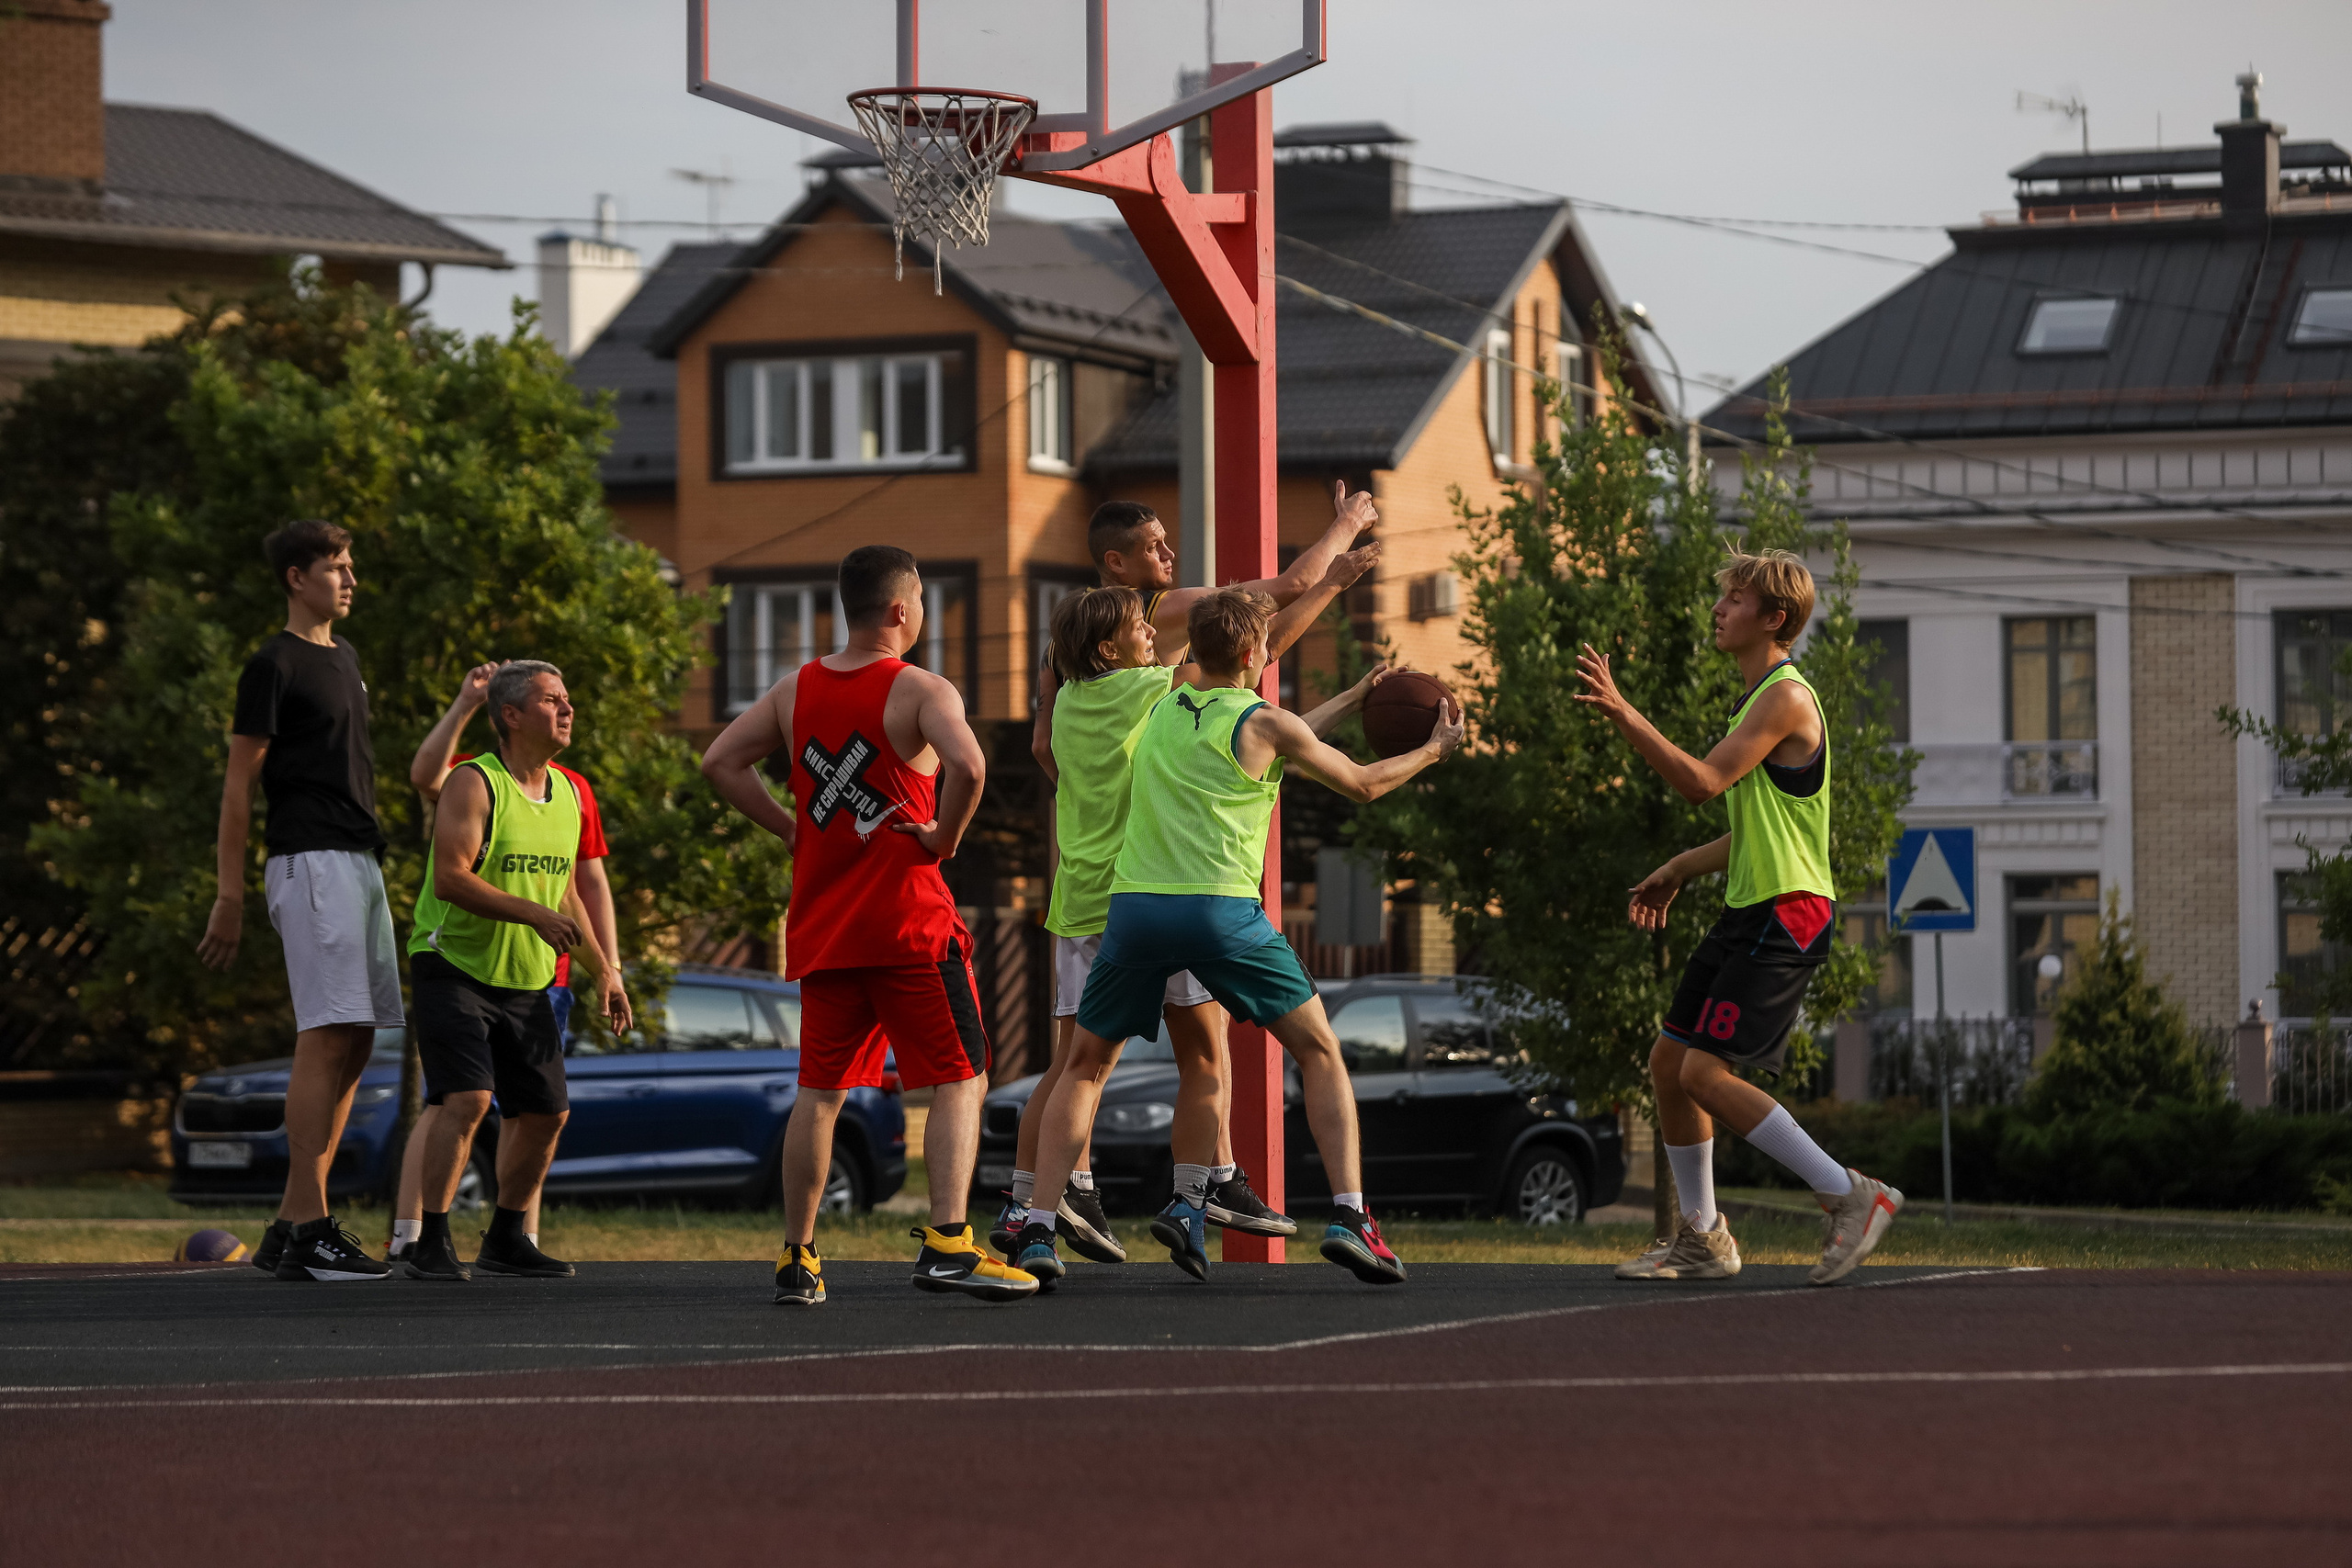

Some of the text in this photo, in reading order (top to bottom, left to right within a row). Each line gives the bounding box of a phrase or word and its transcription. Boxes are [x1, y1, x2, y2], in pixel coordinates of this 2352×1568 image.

[812, 802, 827, 824] НЕ
[1694, 998, 1741, 1040] 18
[1215, 1166, 1233, 1175] PUMA
